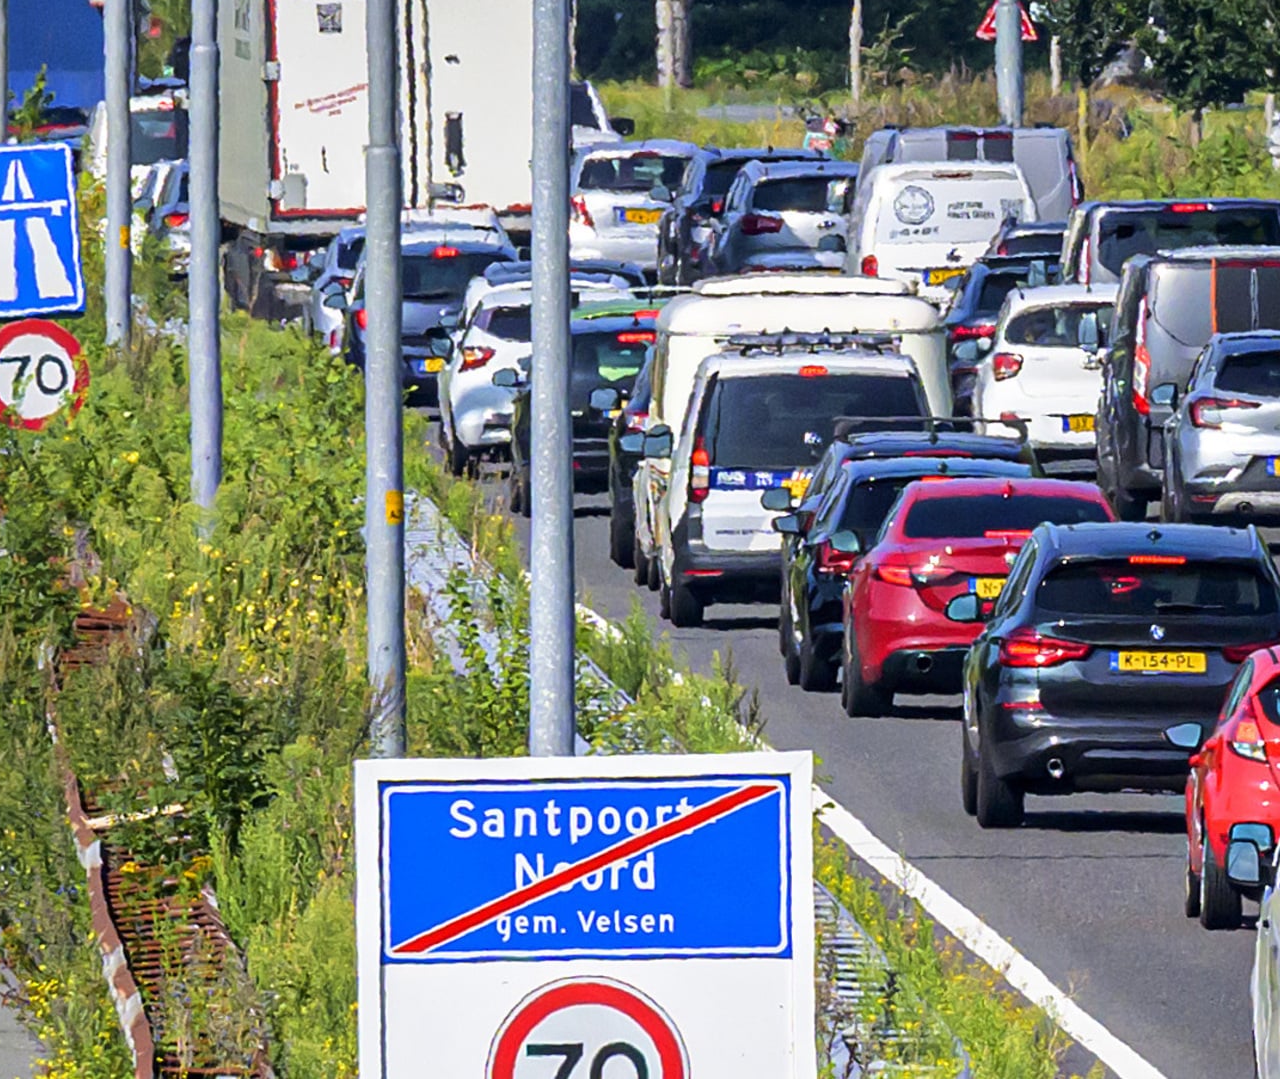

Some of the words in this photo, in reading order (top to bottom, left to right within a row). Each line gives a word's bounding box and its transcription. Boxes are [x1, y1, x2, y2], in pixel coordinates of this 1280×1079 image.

[0, 355, 69, 401] 70
[1124, 653, 1196, 669] K-154-PL
[495, 914, 567, 943] gem.
[576, 909, 675, 934] Velsen
